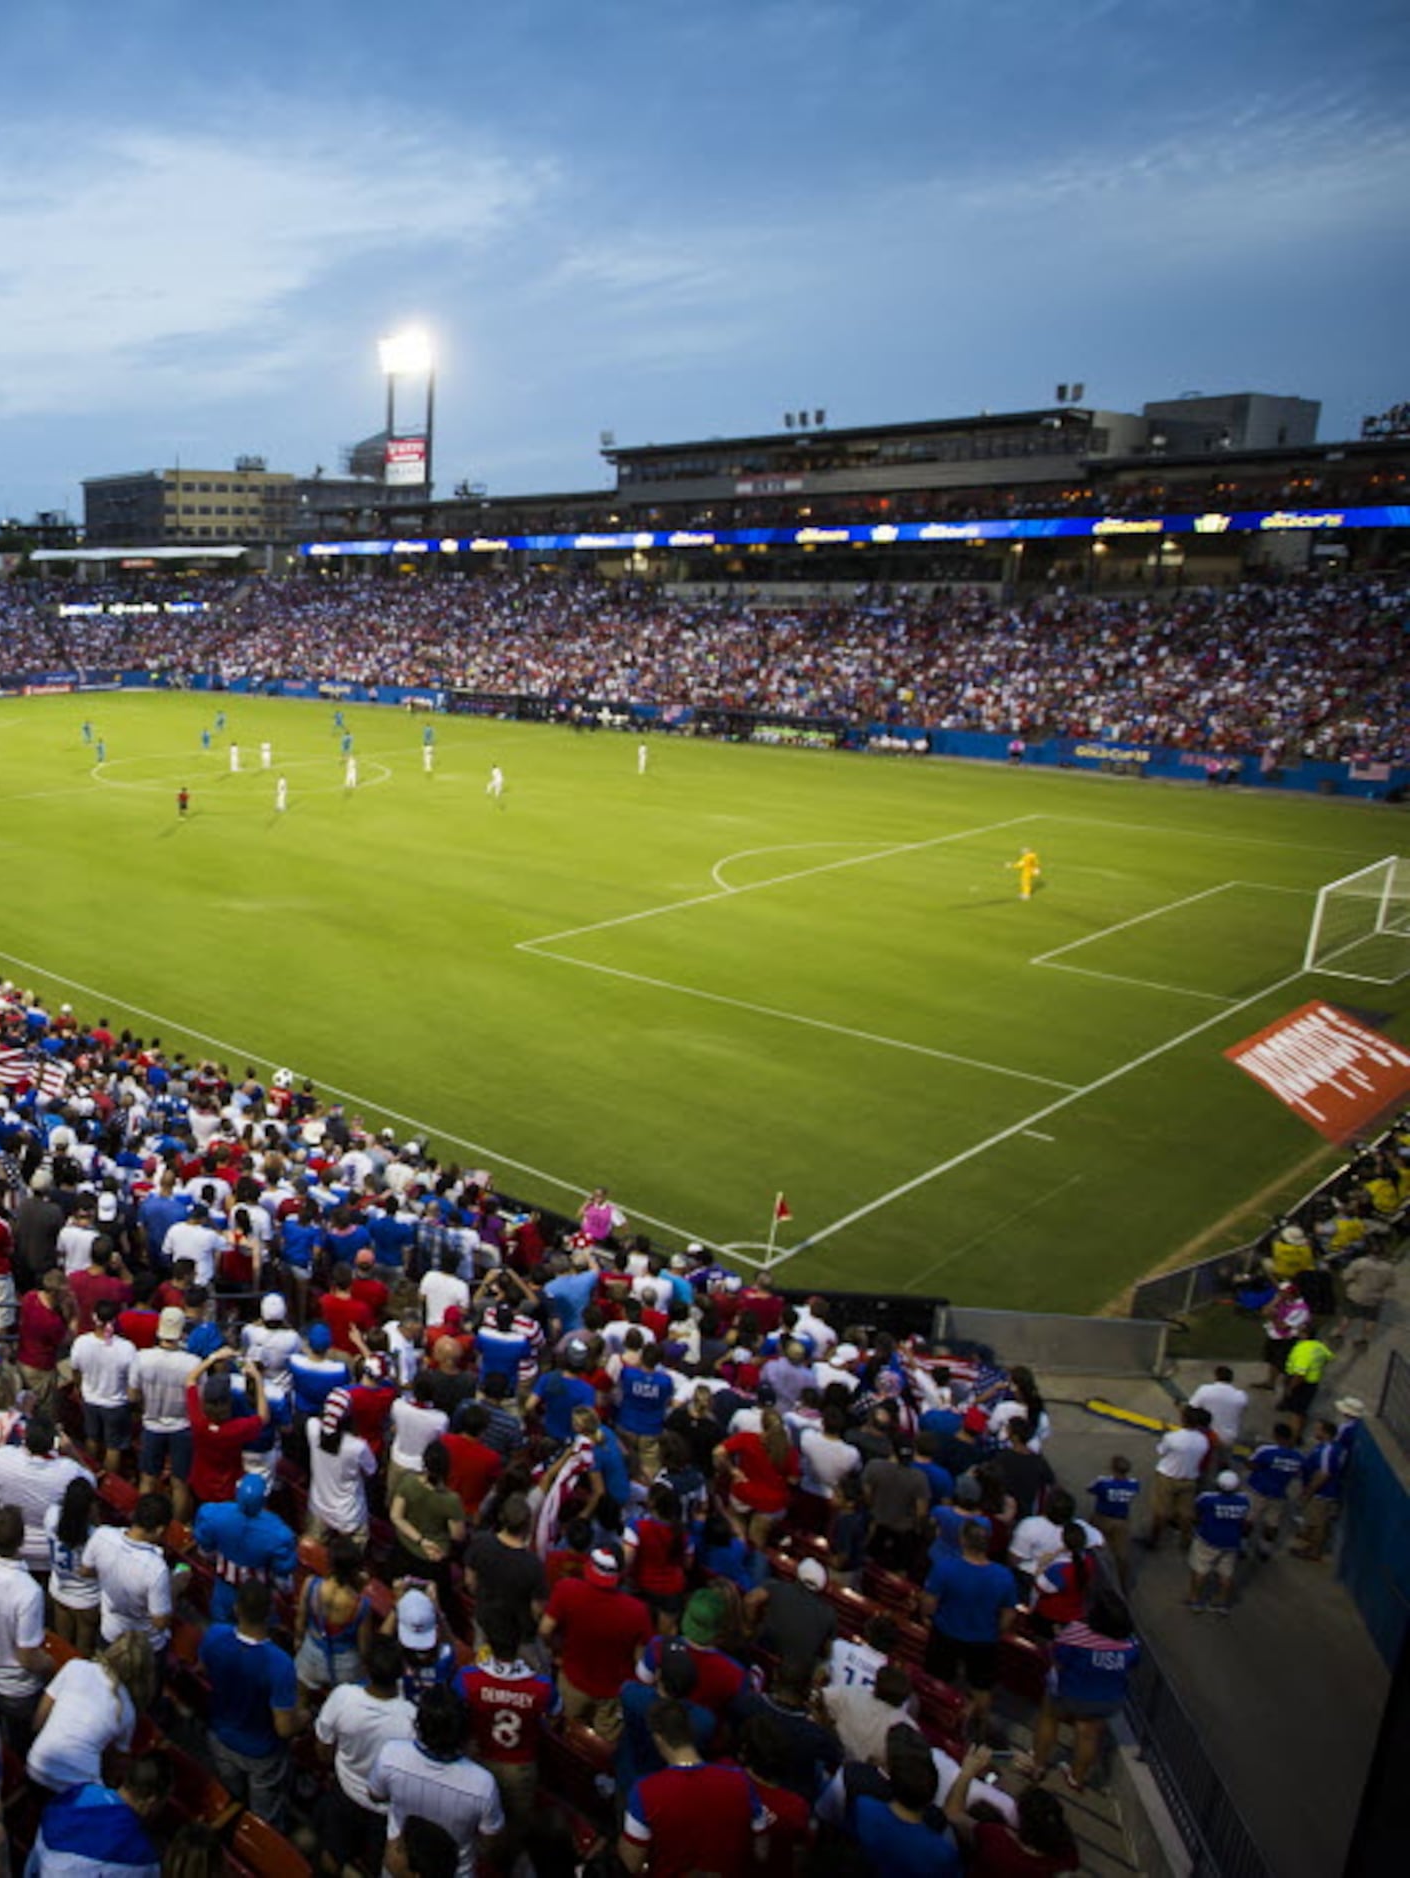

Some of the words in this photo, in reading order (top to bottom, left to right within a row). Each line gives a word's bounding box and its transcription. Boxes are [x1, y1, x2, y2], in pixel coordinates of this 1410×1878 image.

[632, 1381, 660, 1399] USA
[1092, 1650, 1126, 1671] USA
[480, 1686, 535, 1708] DEMPSEY
[491, 1709, 522, 1749] 8
